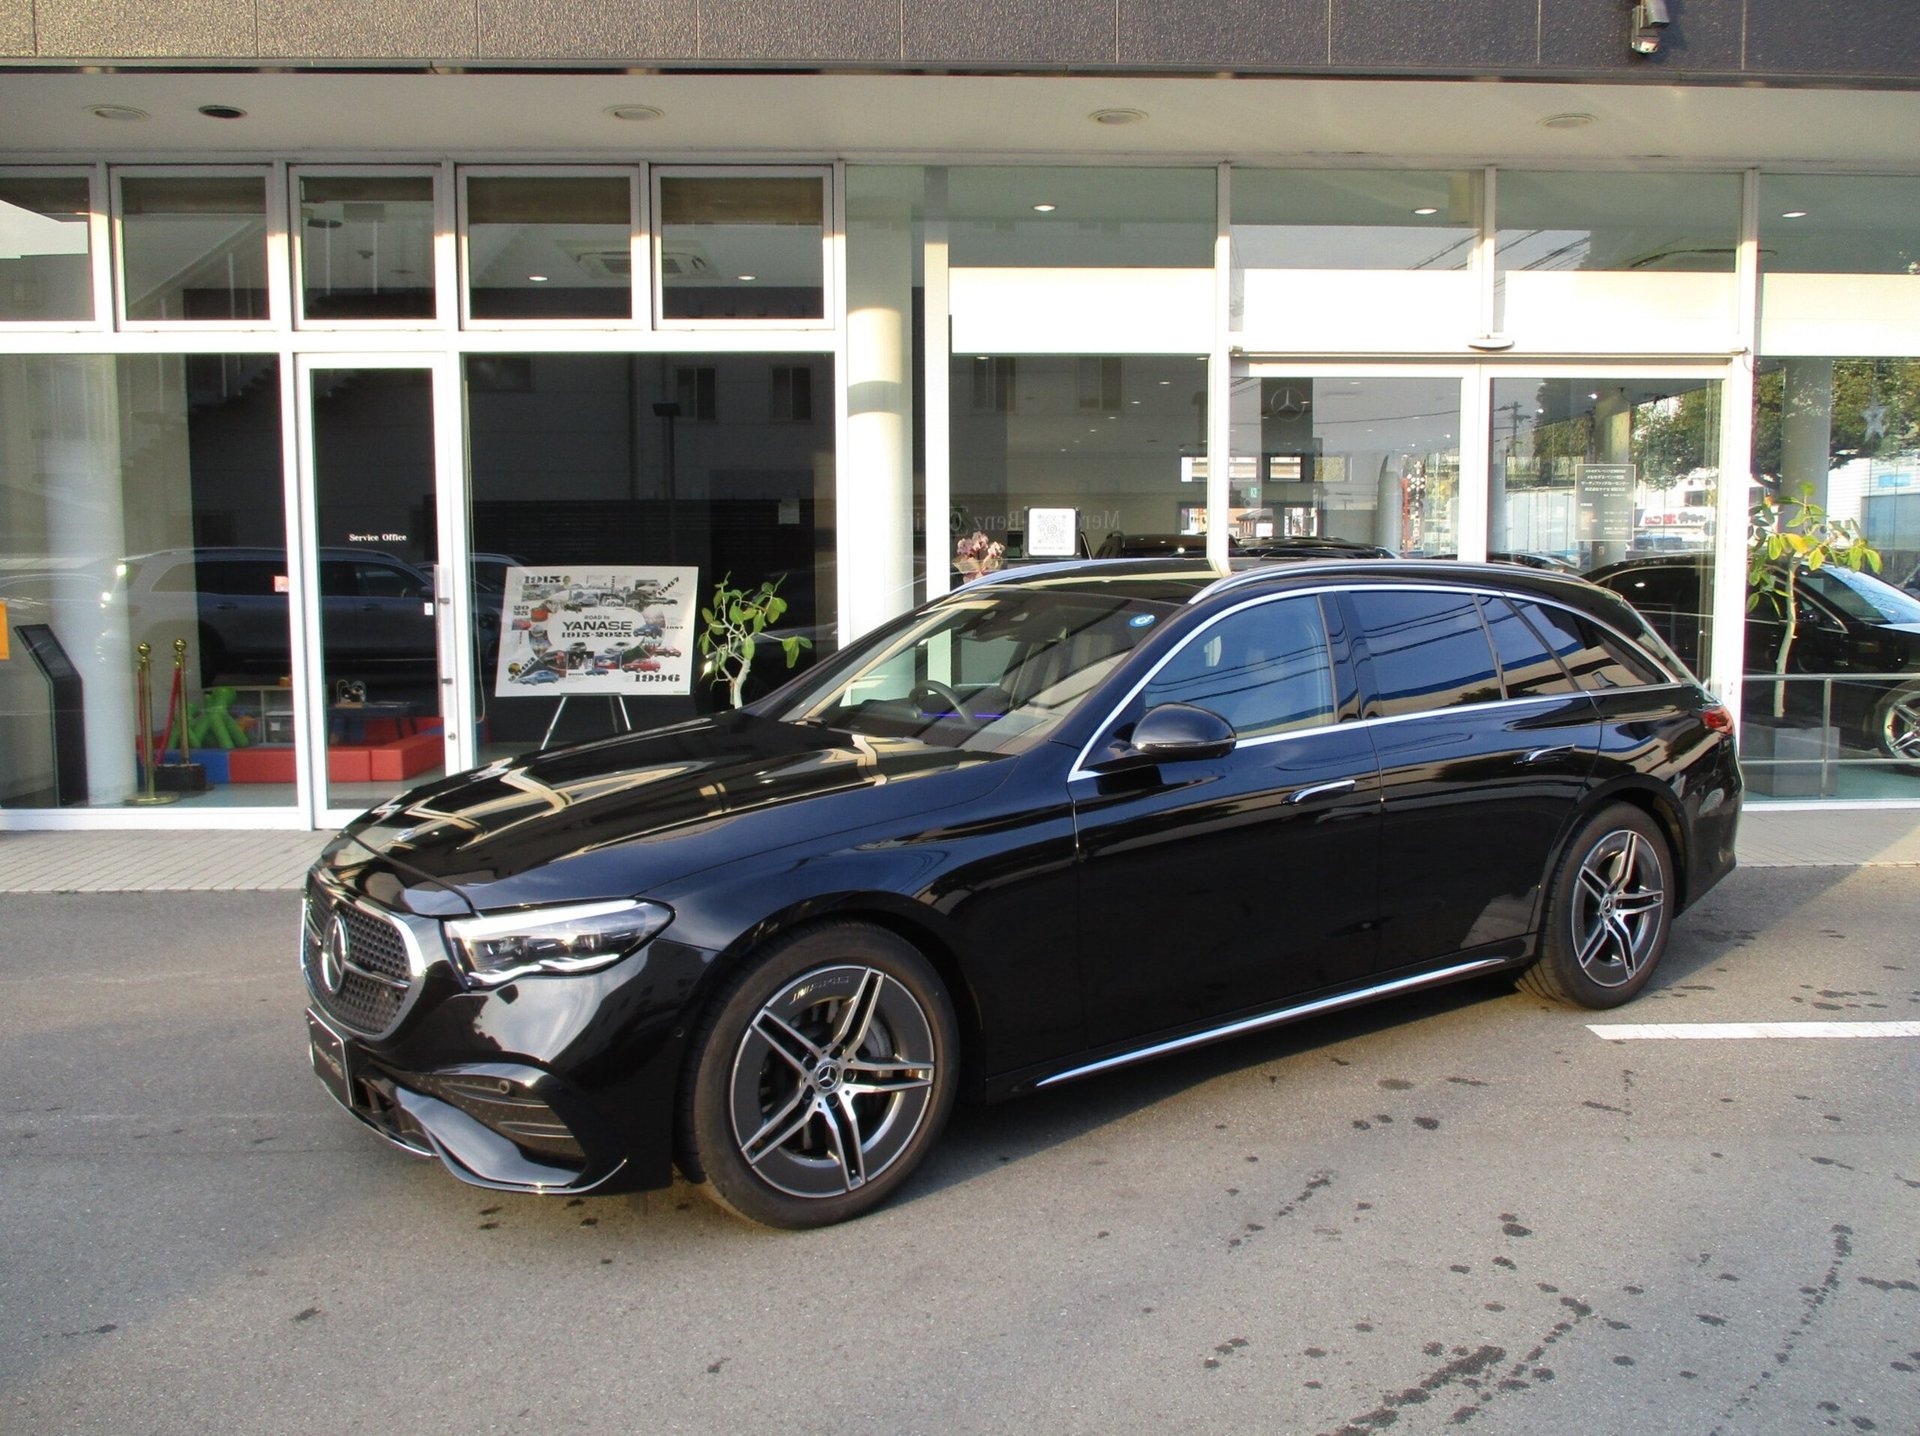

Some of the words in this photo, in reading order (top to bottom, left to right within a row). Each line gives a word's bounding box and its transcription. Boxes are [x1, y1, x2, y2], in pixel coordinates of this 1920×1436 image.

[349, 533, 379, 541] Service
[382, 533, 407, 541] Office
[524, 575, 561, 584] 1915
[563, 621, 632, 630] YANASE
[635, 674, 680, 682] 1996
